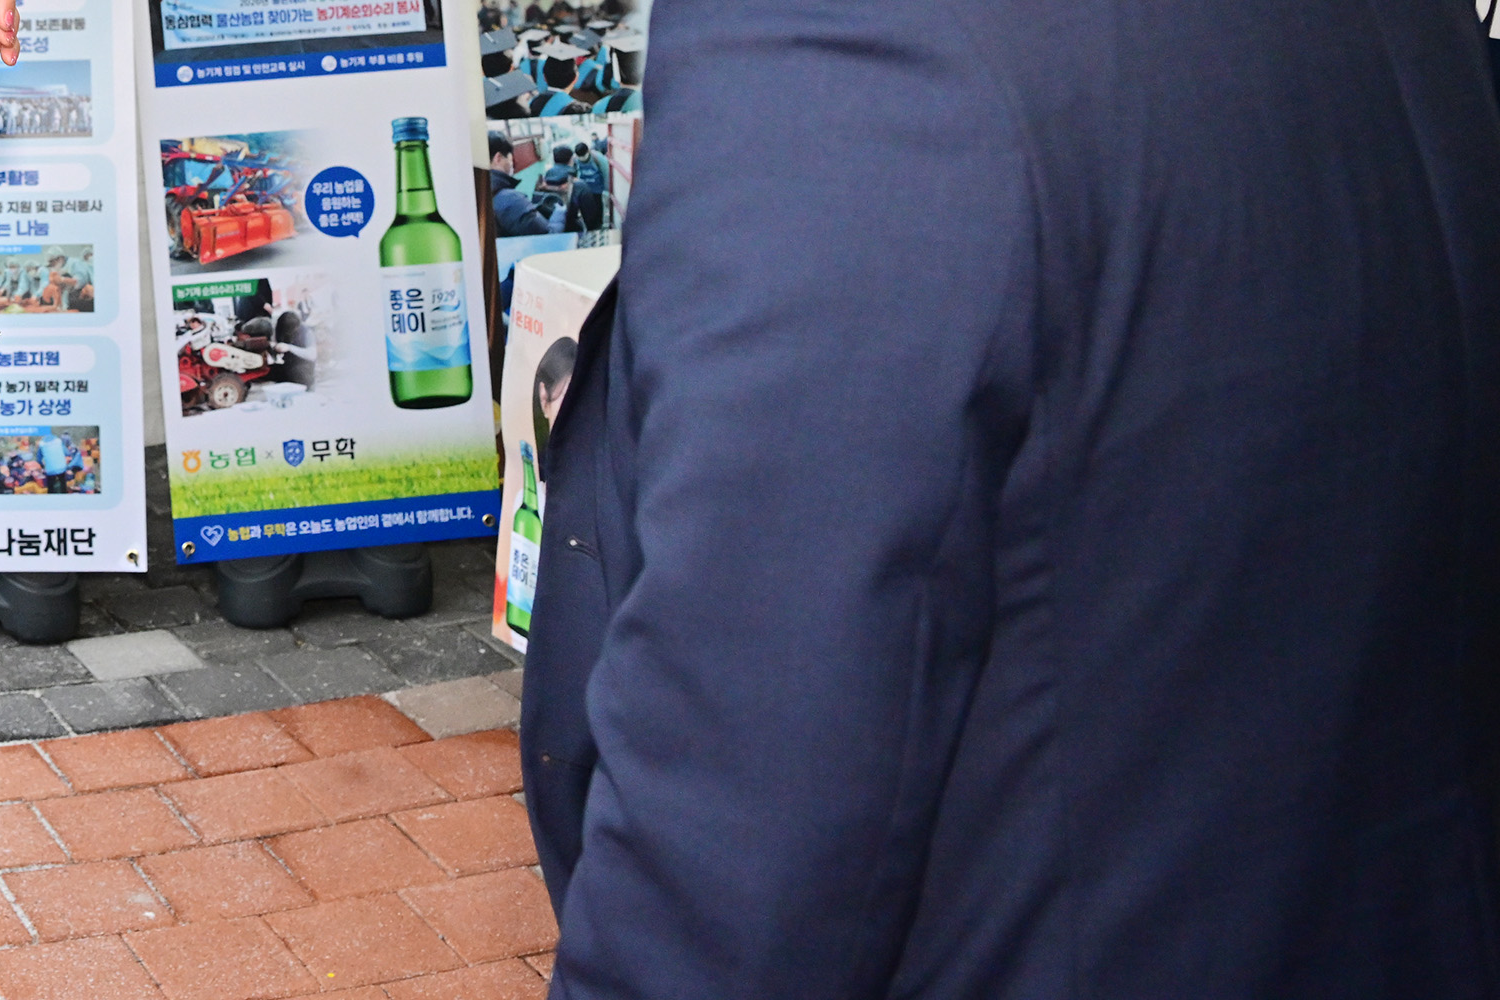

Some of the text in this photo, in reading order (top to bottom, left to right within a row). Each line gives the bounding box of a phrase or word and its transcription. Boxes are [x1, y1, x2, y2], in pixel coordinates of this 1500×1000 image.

[268, 8, 314, 25] 찾아가는
[7, 201, 32, 214] 지원
[16, 219, 50, 237] 나눔
[389, 288, 425, 310] 좋은
[391, 312, 426, 334] 데이
[6, 380, 31, 393] 농가
[63, 379, 89, 393] 지원
[37, 398, 72, 416] 상생
[210, 446, 256, 470] 농협
[311, 437, 357, 462] 무학
[298, 518, 334, 535] 오늘도
